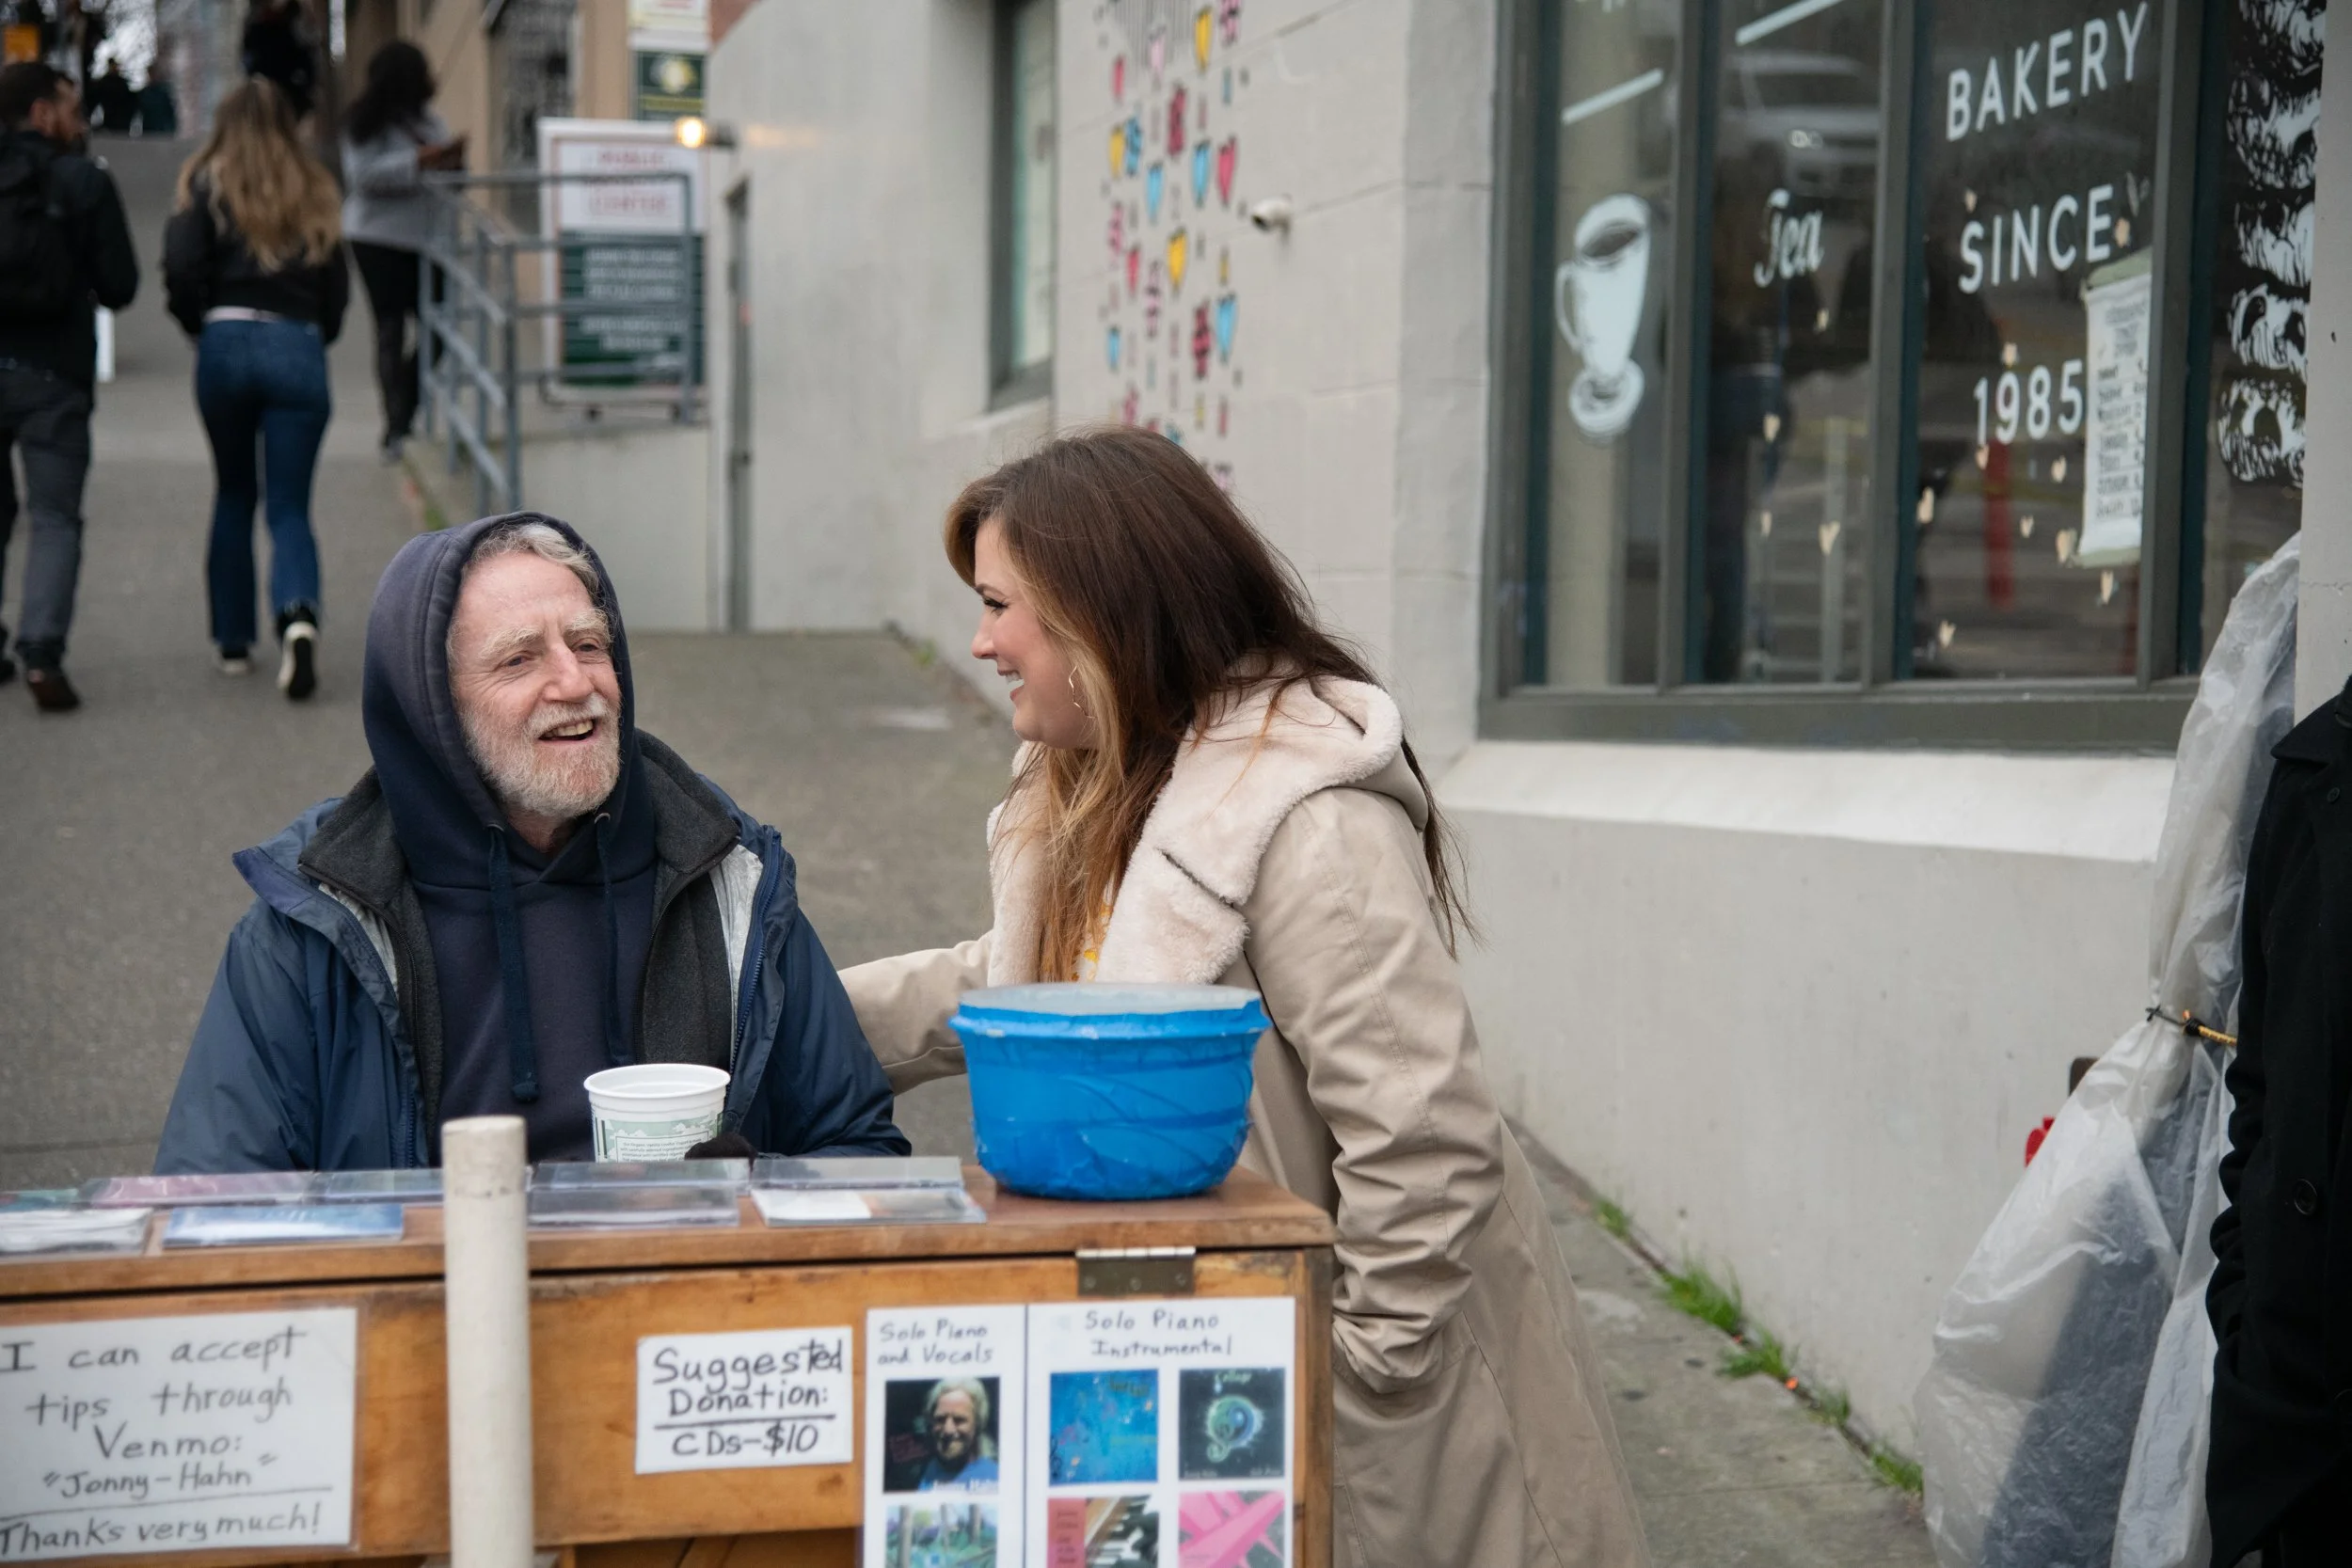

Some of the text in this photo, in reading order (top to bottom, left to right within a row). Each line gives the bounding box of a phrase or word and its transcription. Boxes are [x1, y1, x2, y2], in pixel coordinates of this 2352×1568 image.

[1947, 1, 2148, 142] BAKERY
[1958, 184, 2114, 295] SINCE
[1974, 358, 2083, 446] 1985
[879, 1317, 988, 1342] Solo Piano
[1085, 1307, 1219, 1330] Solo Piano
[0, 1324, 309, 1373] I can accept
[653, 1338, 843, 1395] Suggested
[877, 1341, 994, 1366] and Vocals
[1091, 1333, 1233, 1357] Instrumental
[25, 1375, 293, 1432] tips through
[669, 1378, 829, 1417] Donation:
[94, 1419, 243, 1459] Venmo:
[0, 1501, 322, 1557] Thanks very much!
